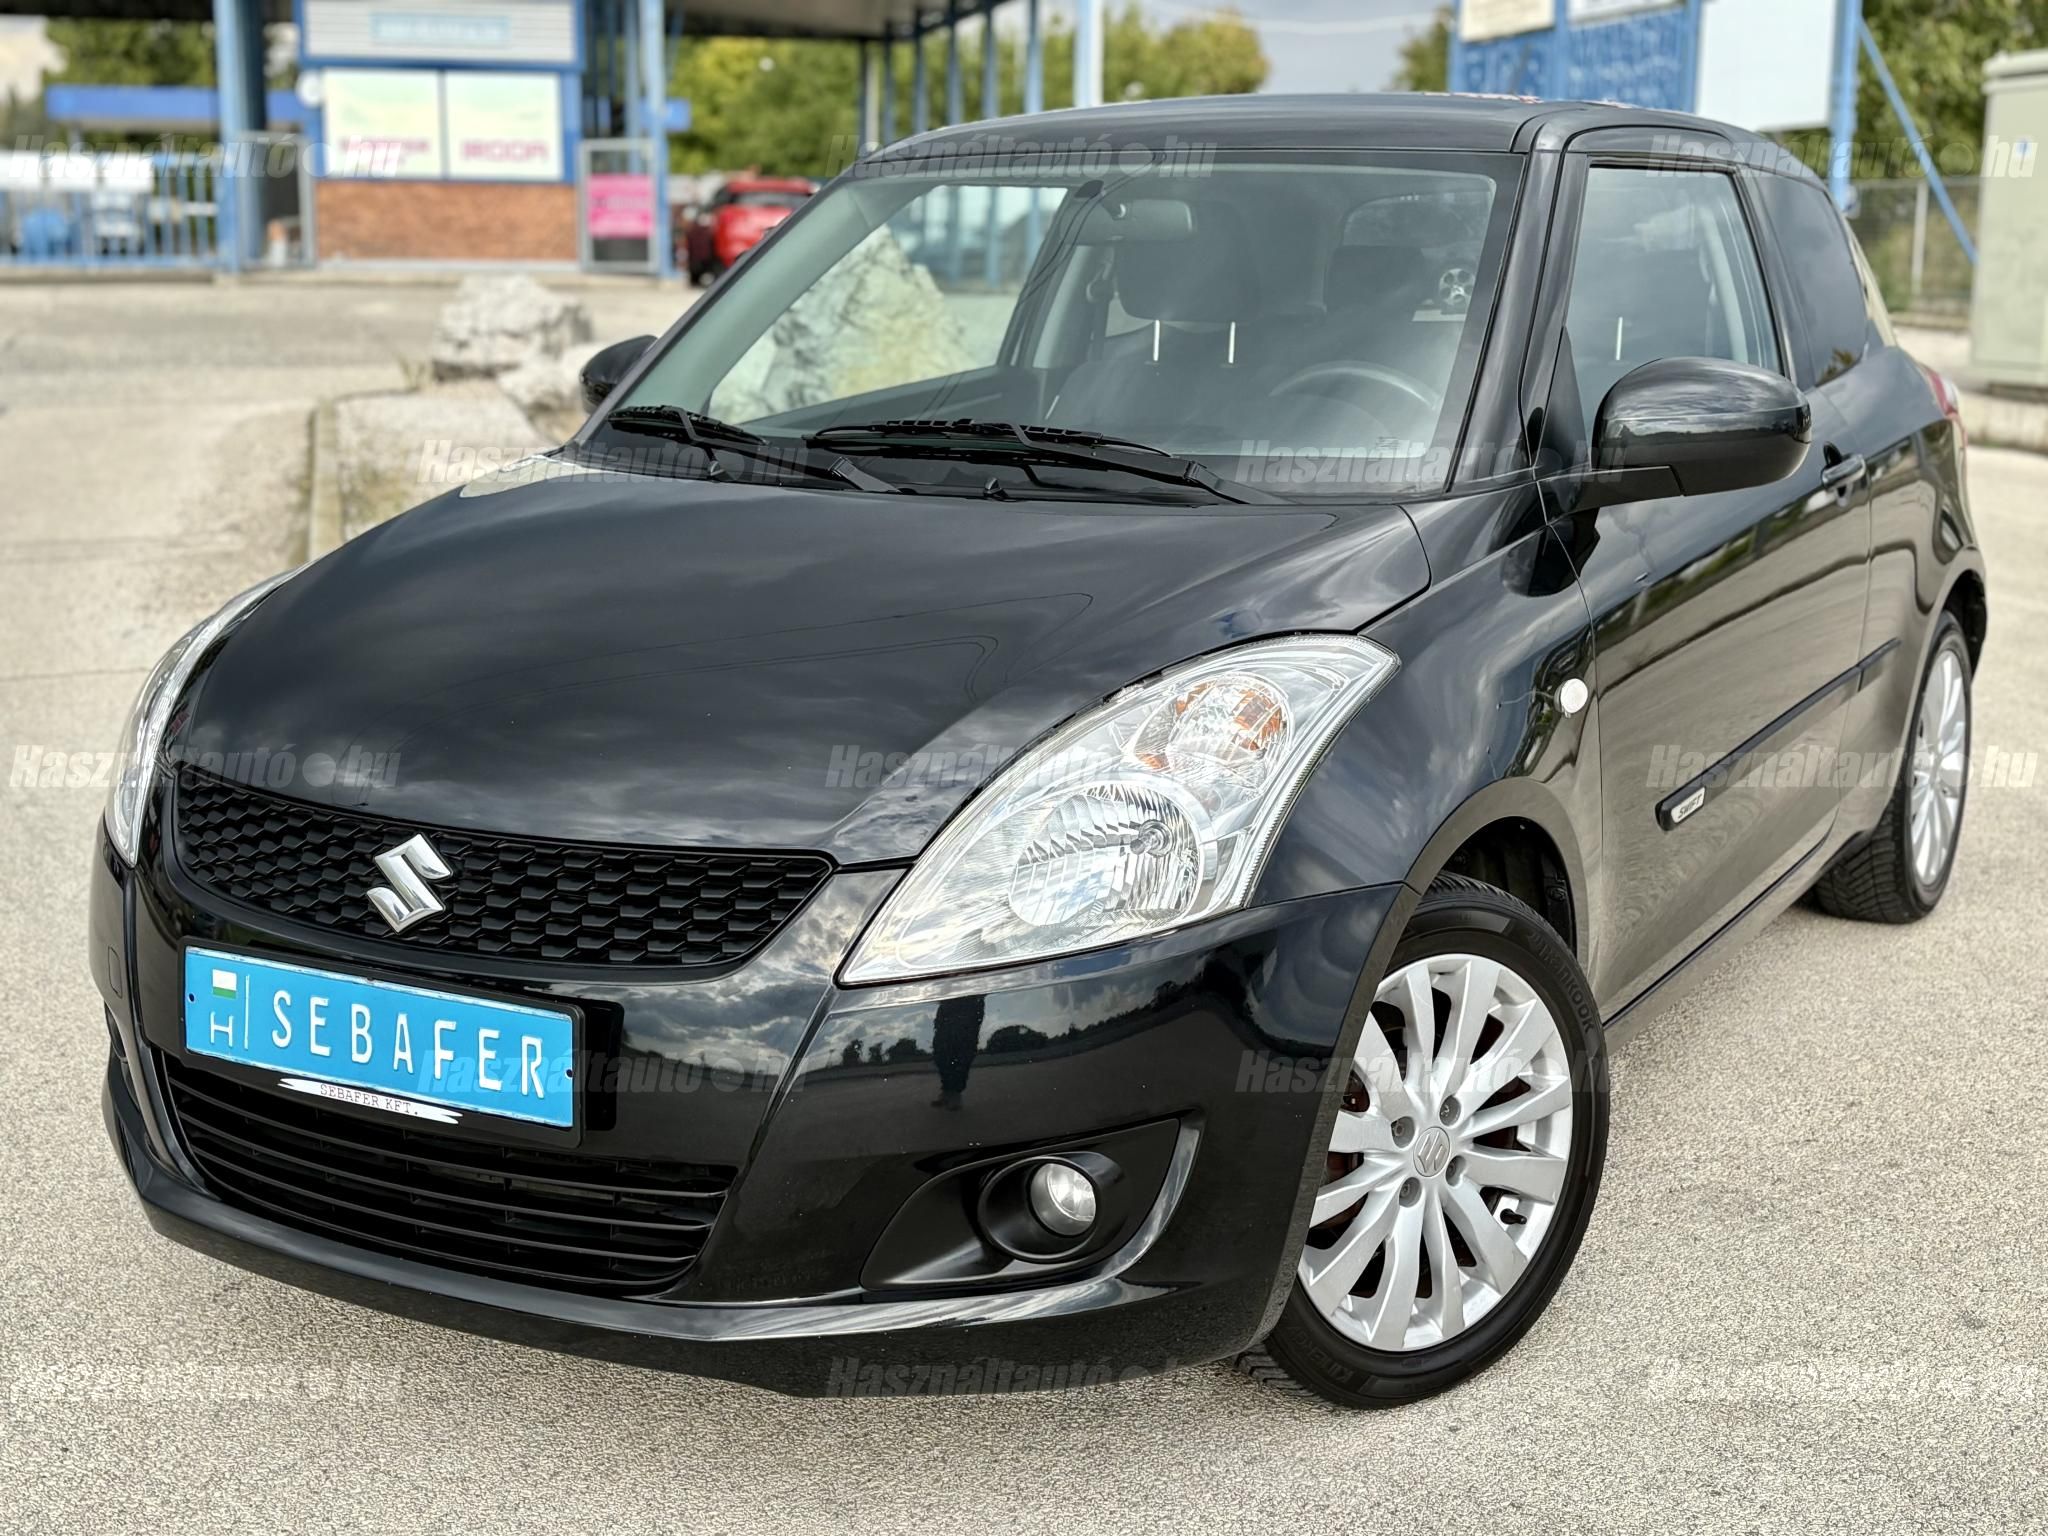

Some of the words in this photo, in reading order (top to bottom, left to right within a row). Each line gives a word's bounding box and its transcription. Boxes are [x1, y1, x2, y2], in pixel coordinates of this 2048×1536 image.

[1677, 793, 1703, 819] SWIFT
[271, 989, 546, 1099] SEBAFER
[319, 1082, 380, 1109] SEBAFER
[385, 1097, 419, 1116] KFT.
